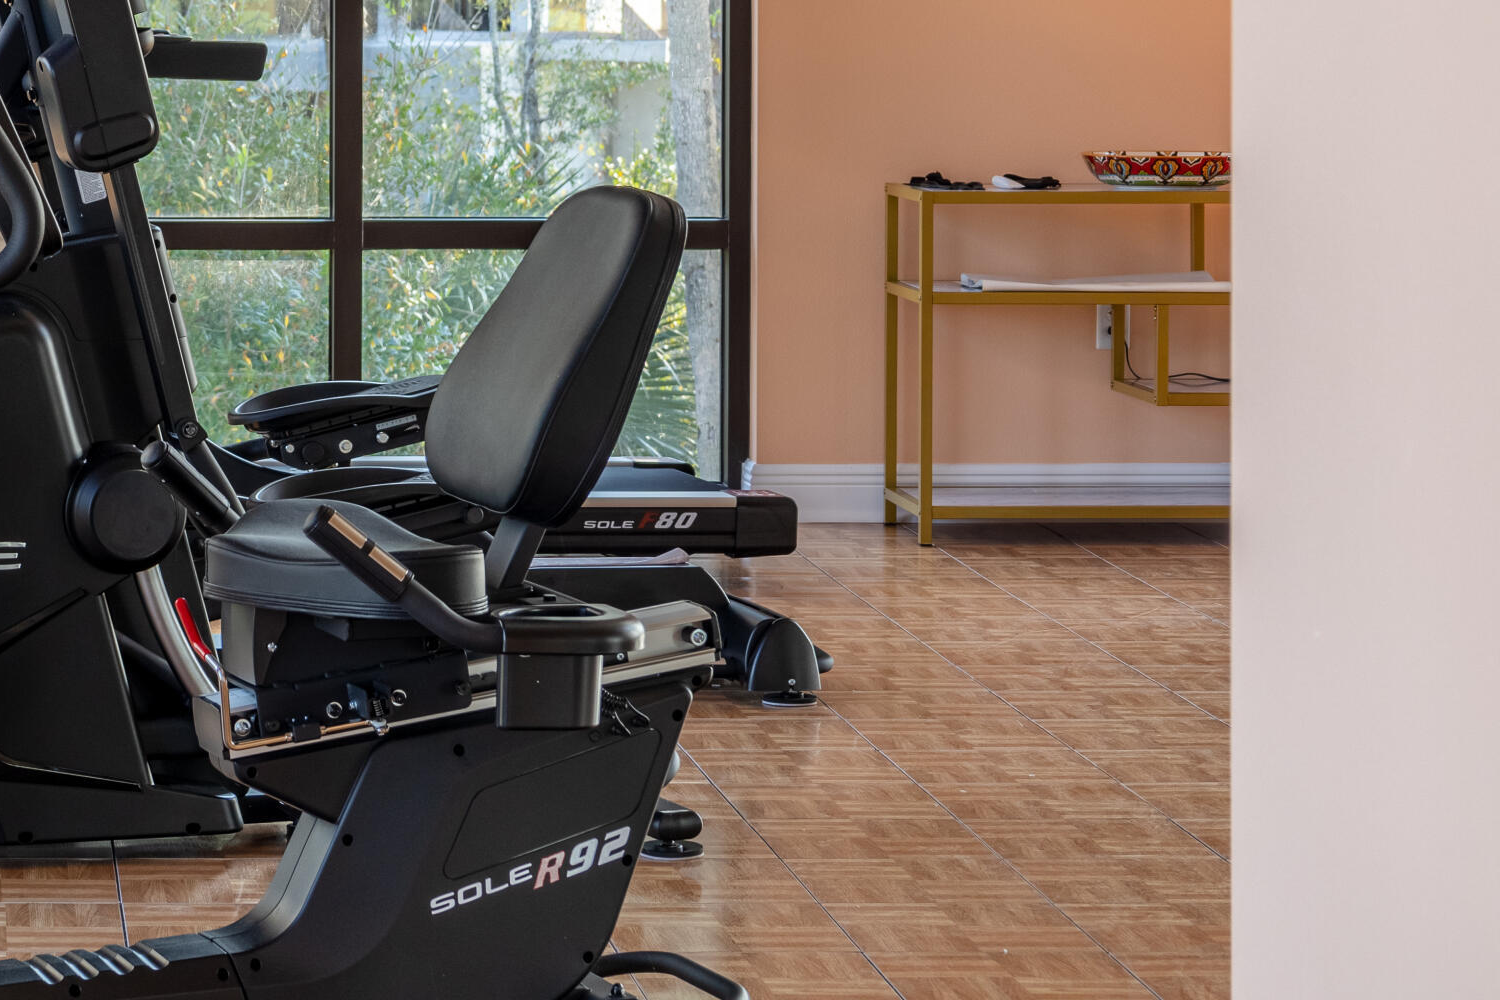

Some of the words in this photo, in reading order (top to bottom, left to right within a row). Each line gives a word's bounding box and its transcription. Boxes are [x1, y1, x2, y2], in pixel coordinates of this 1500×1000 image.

[583, 520, 635, 529] SOLE
[638, 511, 698, 529] F80
[430, 863, 533, 915] SOLE
[533, 825, 631, 891] R92
